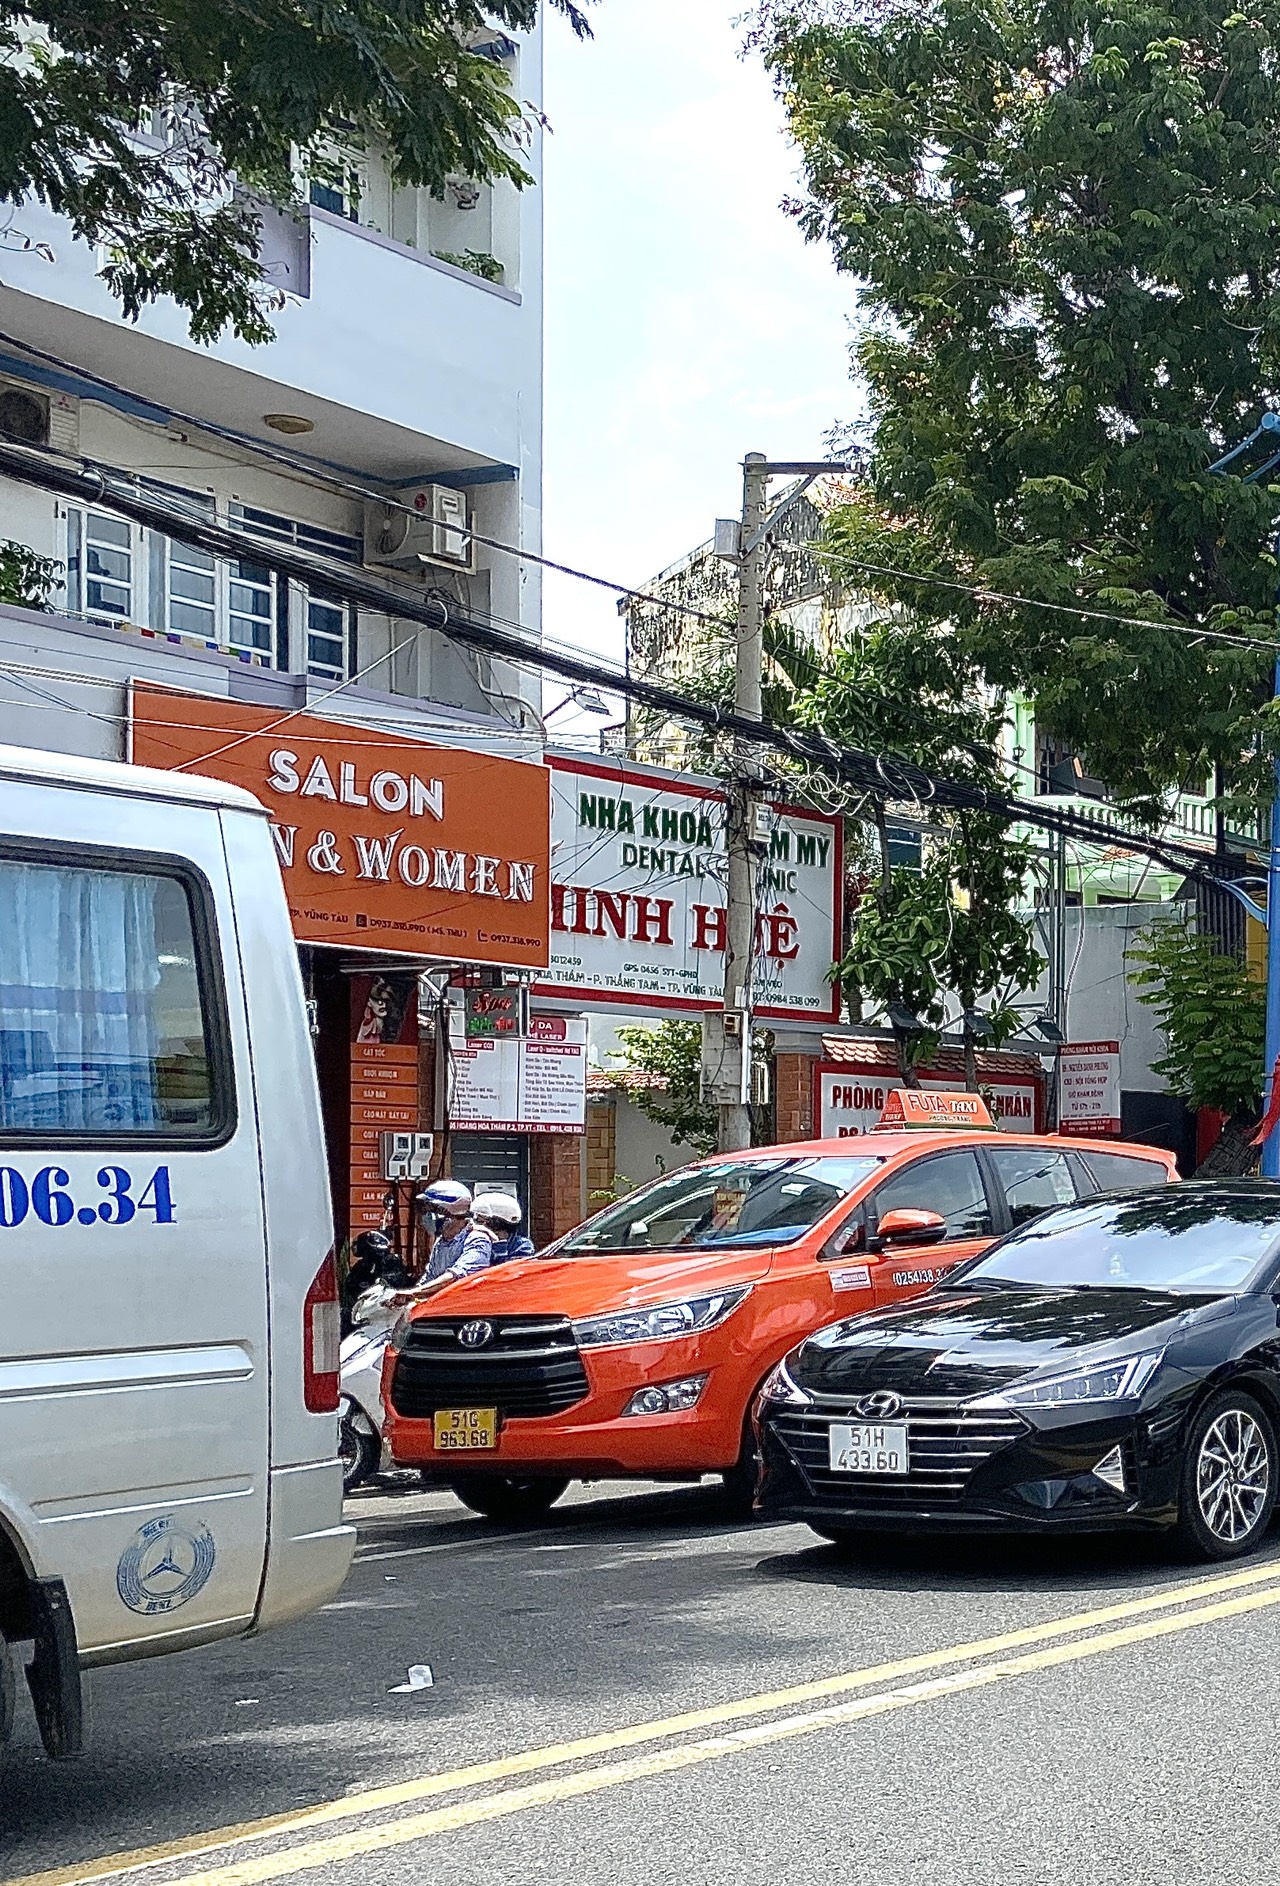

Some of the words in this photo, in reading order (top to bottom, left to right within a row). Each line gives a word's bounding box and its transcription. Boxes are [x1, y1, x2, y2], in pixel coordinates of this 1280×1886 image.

[266, 748, 445, 822] SALON
[579, 793, 634, 834] NHA
[643, 804, 712, 848] KHOA
[307, 830, 346, 876] &
[351, 828, 538, 903] WOMEN
[621, 841, 706, 879] DENTAL
[538, 1021, 552, 1030] DA
[831, 1081, 883, 1110] PHÒNG
[908, 1093, 949, 1113] FUTA
[949, 1100, 978, 1113] TAXI
[452, 1411, 478, 1428] 51G
[440, 1430, 488, 1447] 963.68
[851, 1427, 885, 1447] 51H
[838, 1449, 899, 1471] 433.60
